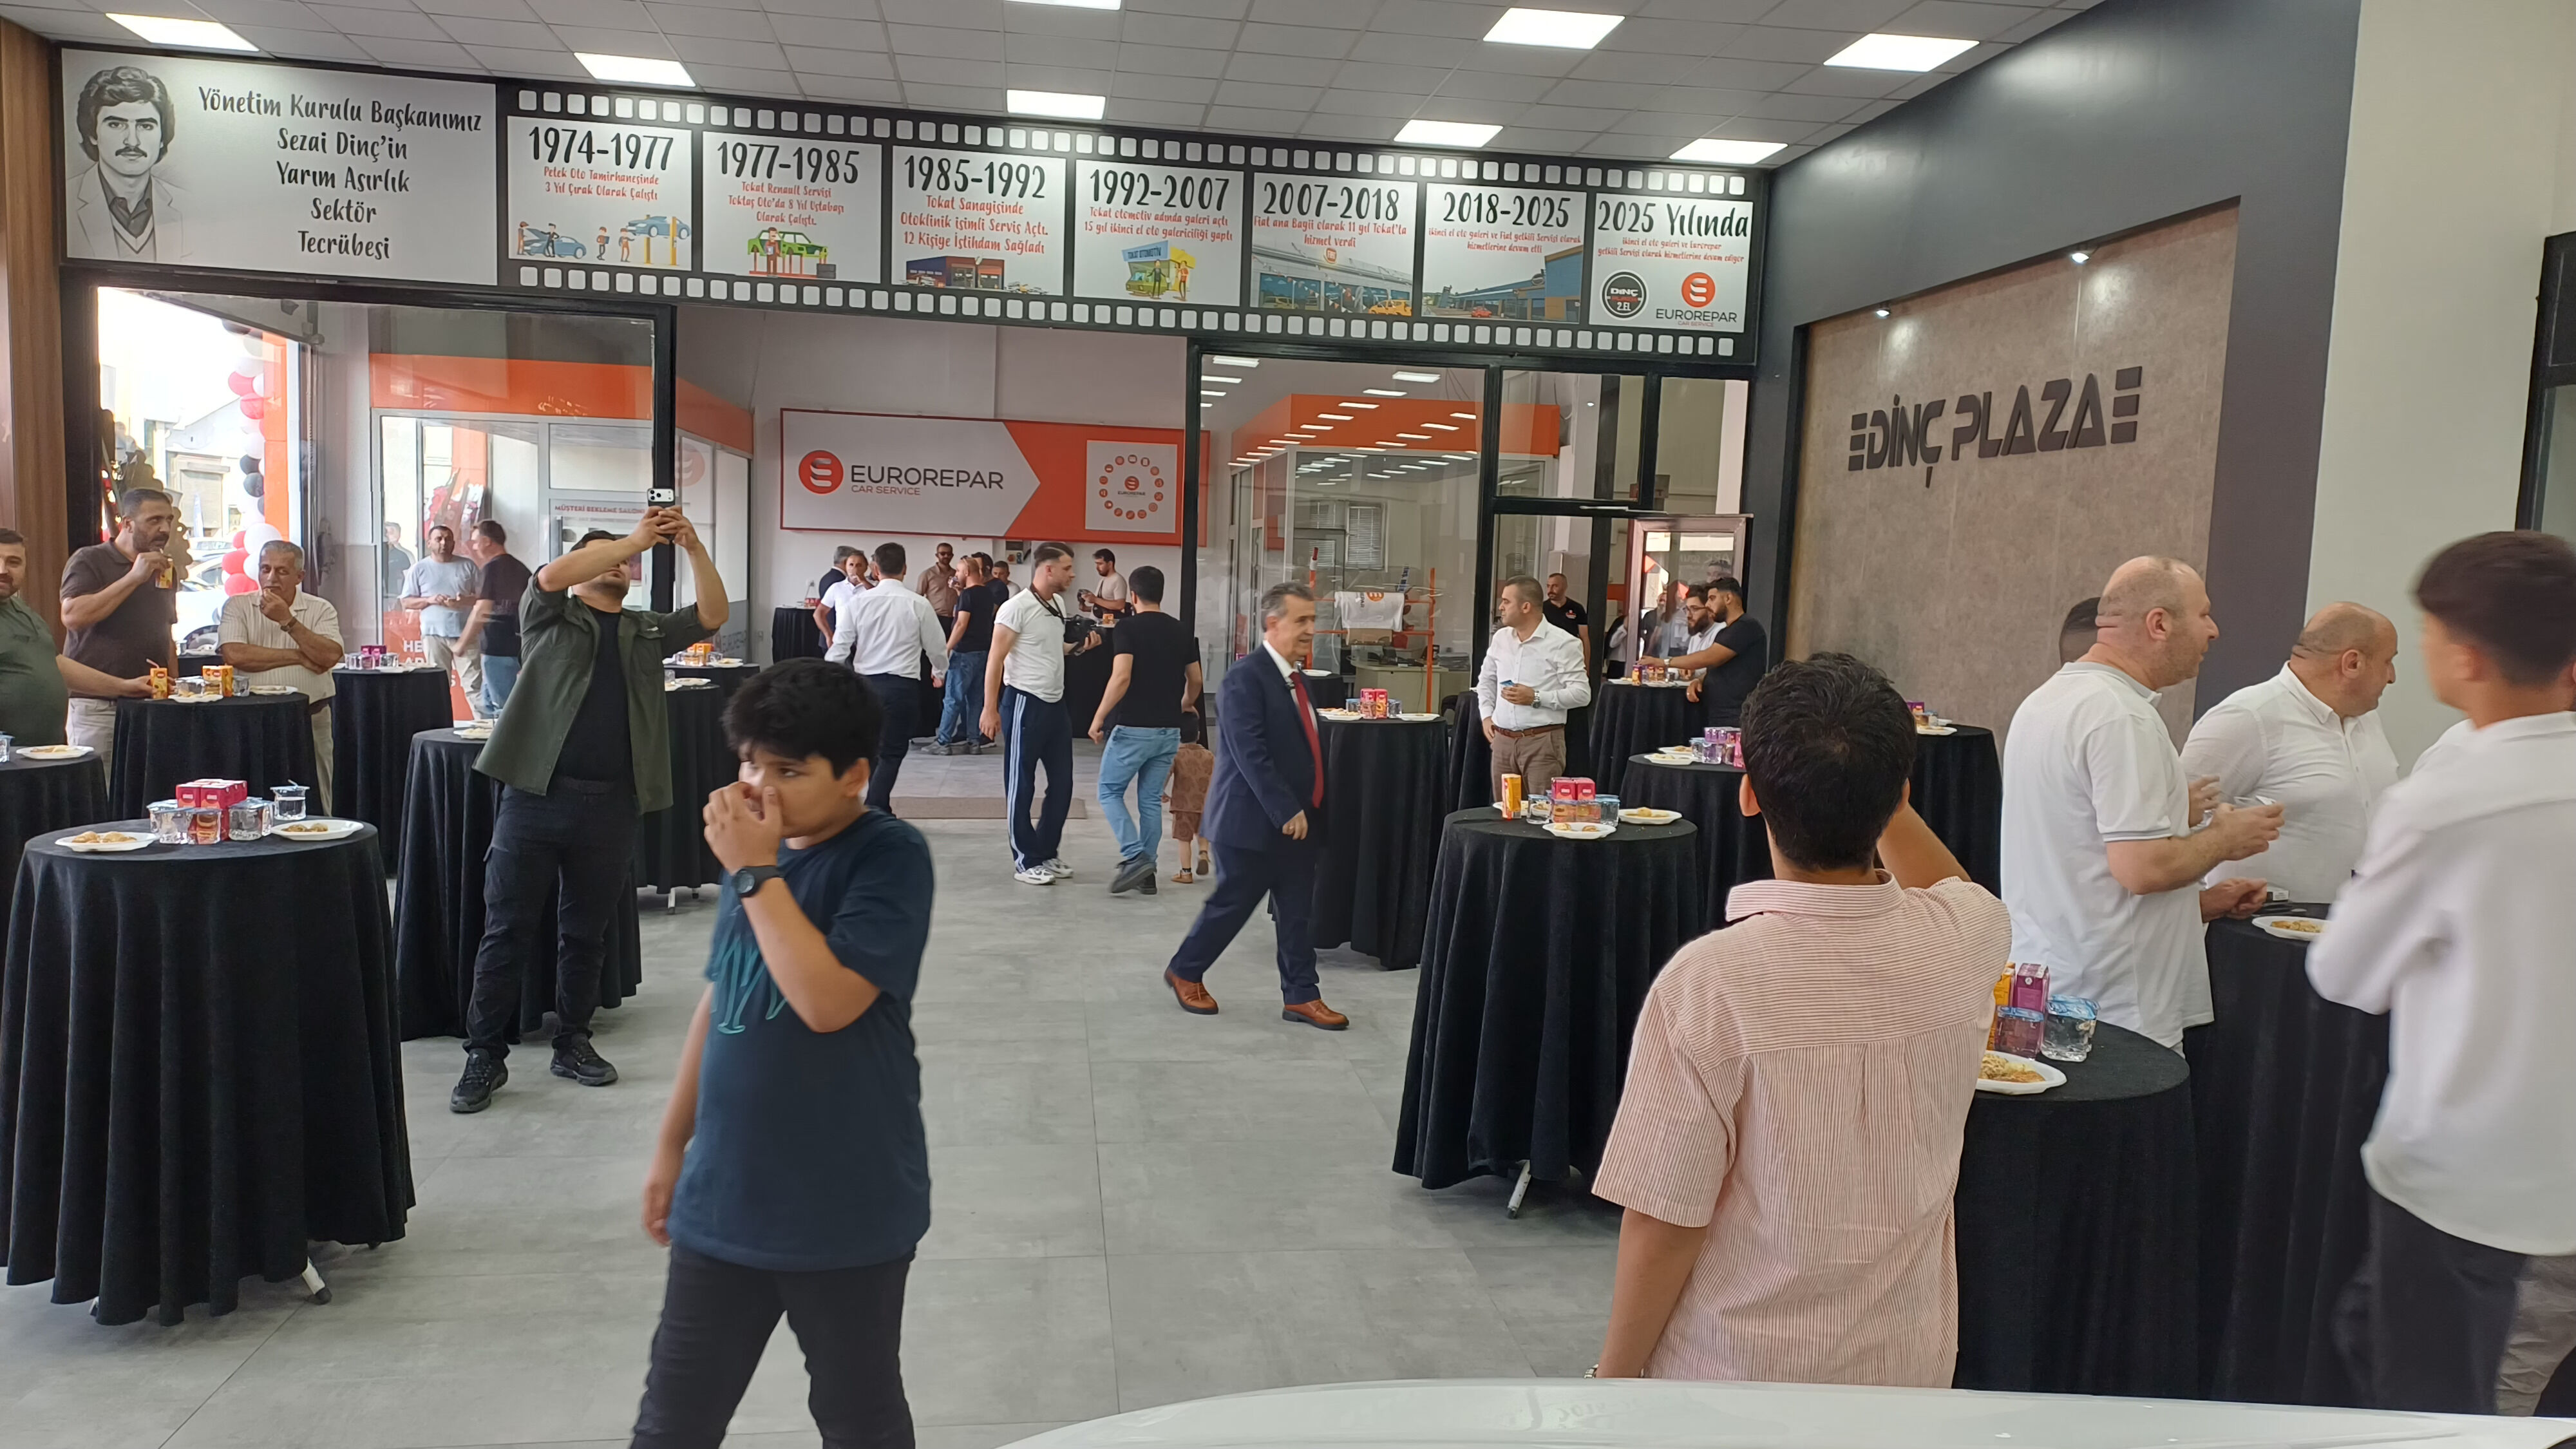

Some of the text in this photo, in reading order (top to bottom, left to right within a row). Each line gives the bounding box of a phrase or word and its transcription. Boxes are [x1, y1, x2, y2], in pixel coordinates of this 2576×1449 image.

[198, 86, 481, 131] Yönetim Kurulu Başkanımız
[278, 128, 407, 162] Sezai Dinç'in
[529, 127, 673, 170] 1974-1977
[717, 141, 859, 184] 1977-1985
[276, 160, 410, 193] Yarım Asırlık
[544, 166, 659, 185] Petek Oto Tamirhanesinde
[904, 155, 1045, 198] 1985-1992
[545, 182, 658, 202] 3 Yıl Çırak Olarak Çalıştı
[742, 181, 831, 198] Tokat Renault Servisi
[1090, 169, 1229, 211] 1992-2007
[1263, 182, 1399, 221] 2007-2018
[311, 198, 377, 223] Sektör
[728, 195, 755, 208] Toktaş
[788, 199, 793, 209] 8
[796, 199, 808, 211] Yıl
[926, 194, 1023, 216] Tokat Sanayisinde
[1443, 191, 1571, 227] 2018-2025
[757, 211, 786, 223] Olarak
[900, 211, 1048, 237] Otoklinik isimli Servis Açtı.
[1090, 207, 1227, 227] Tokat otomotiv adında galeri açtı
[1254, 216, 1270, 227] Fiat
[1273, 219, 1289, 228] ana
[1317, 220, 1345, 231] olarak
[1348, 222, 1356, 232] 11
[1359, 223, 1369, 235] yıl
[1598, 200, 1748, 237] 2025 Yılında
[904, 232, 1045, 256] 12 Kişiye İstihdam Sağladı
[1084, 222, 1233, 242] 15 yıl ikinci el oto galericiliği yaptı
[1304, 234, 1331, 246] hizmet
[1428, 227, 1446, 237] ikinci
[1448, 229, 1454, 237] el
[1469, 230, 1488, 241] galeri
[298, 231, 390, 260] Tecrübesi
[1656, 308, 1737, 323] EUROREPAR
[1951, 373, 2106, 461] PLAZA
[851, 464, 1003, 489] EUROREPAR
[851, 485, 920, 496] CAR SERVICE
